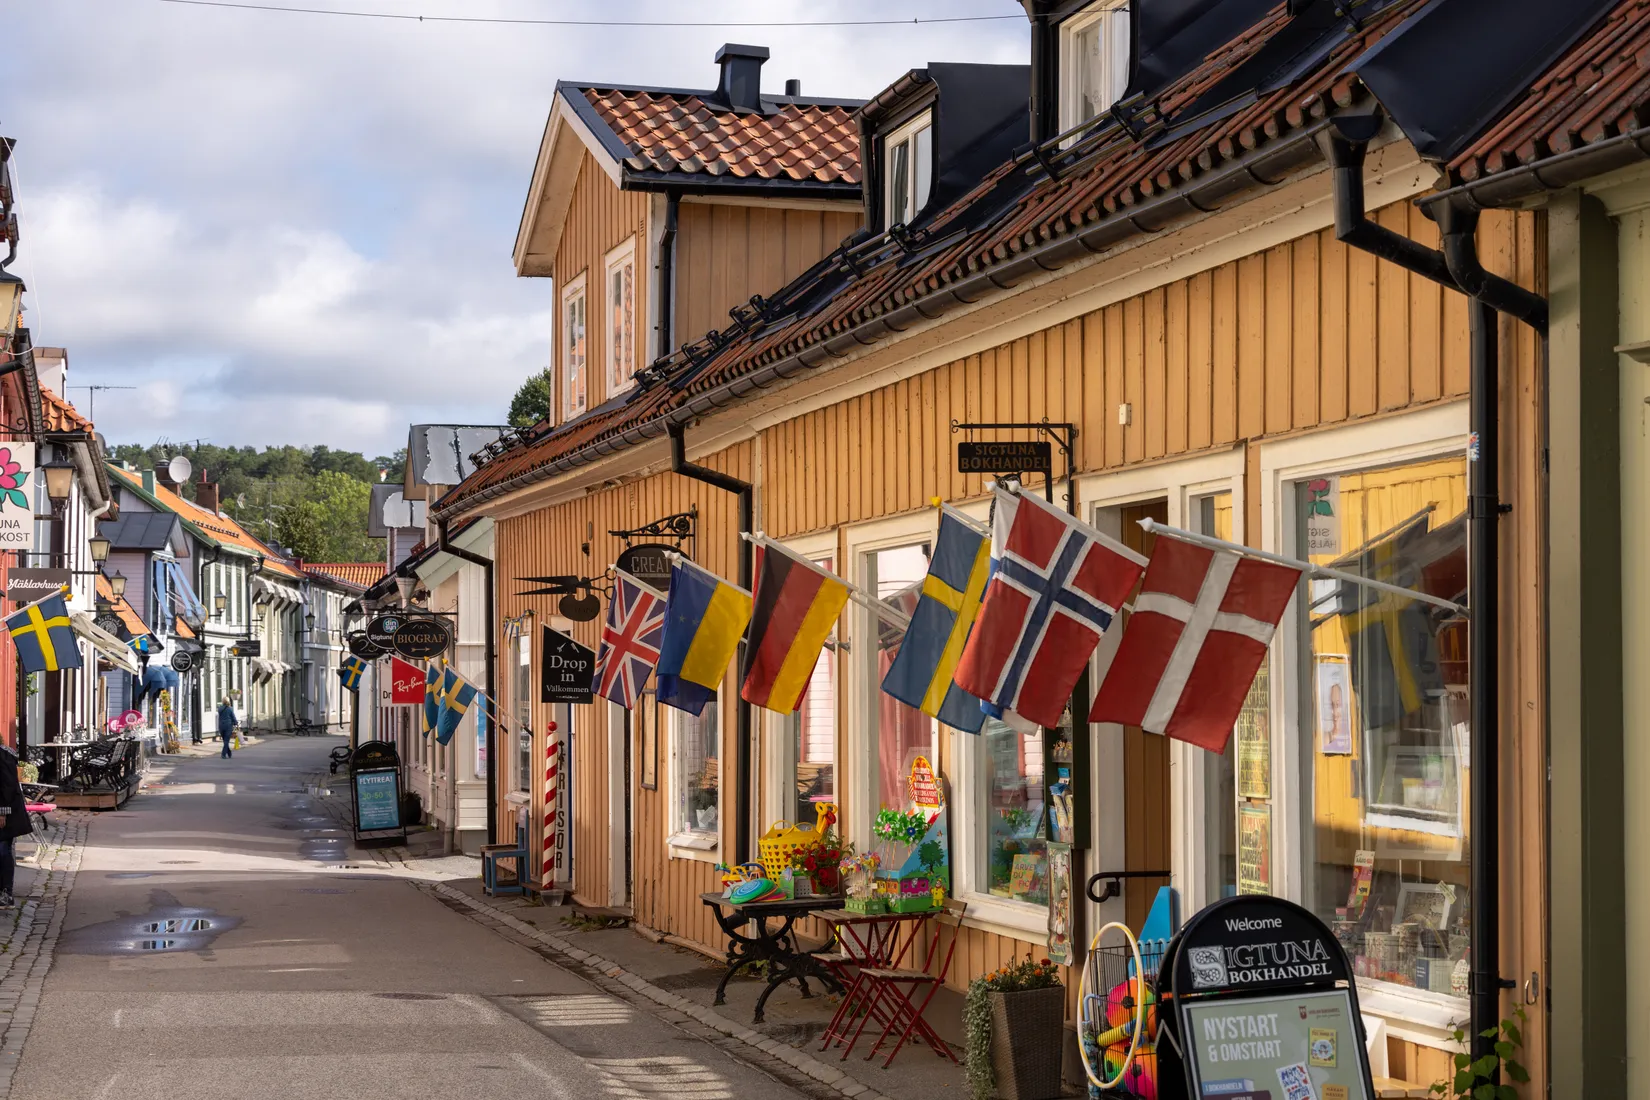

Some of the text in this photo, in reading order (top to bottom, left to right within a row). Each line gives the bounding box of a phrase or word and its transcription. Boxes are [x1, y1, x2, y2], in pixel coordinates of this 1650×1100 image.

[975, 444, 1037, 456] SIGTUNA
[960, 457, 1050, 470] BOKHANDEL
[0, 532, 31, 542] KOST
[7, 578, 67, 590] Mäklarhuset
[396, 633, 445, 644] BIOGRAF
[550, 655, 588, 672] Drop
[560, 670, 575, 682] in
[393, 676, 423, 692] Ray-Ban
[546, 684, 589, 693] Välkommen
[1225, 917, 1283, 932] Welcome
[1229, 962, 1333, 984] BOKHANDEL
[1203, 1014, 1278, 1041] NYSTART
[1208, 1040, 1282, 1062] & OMSTART
